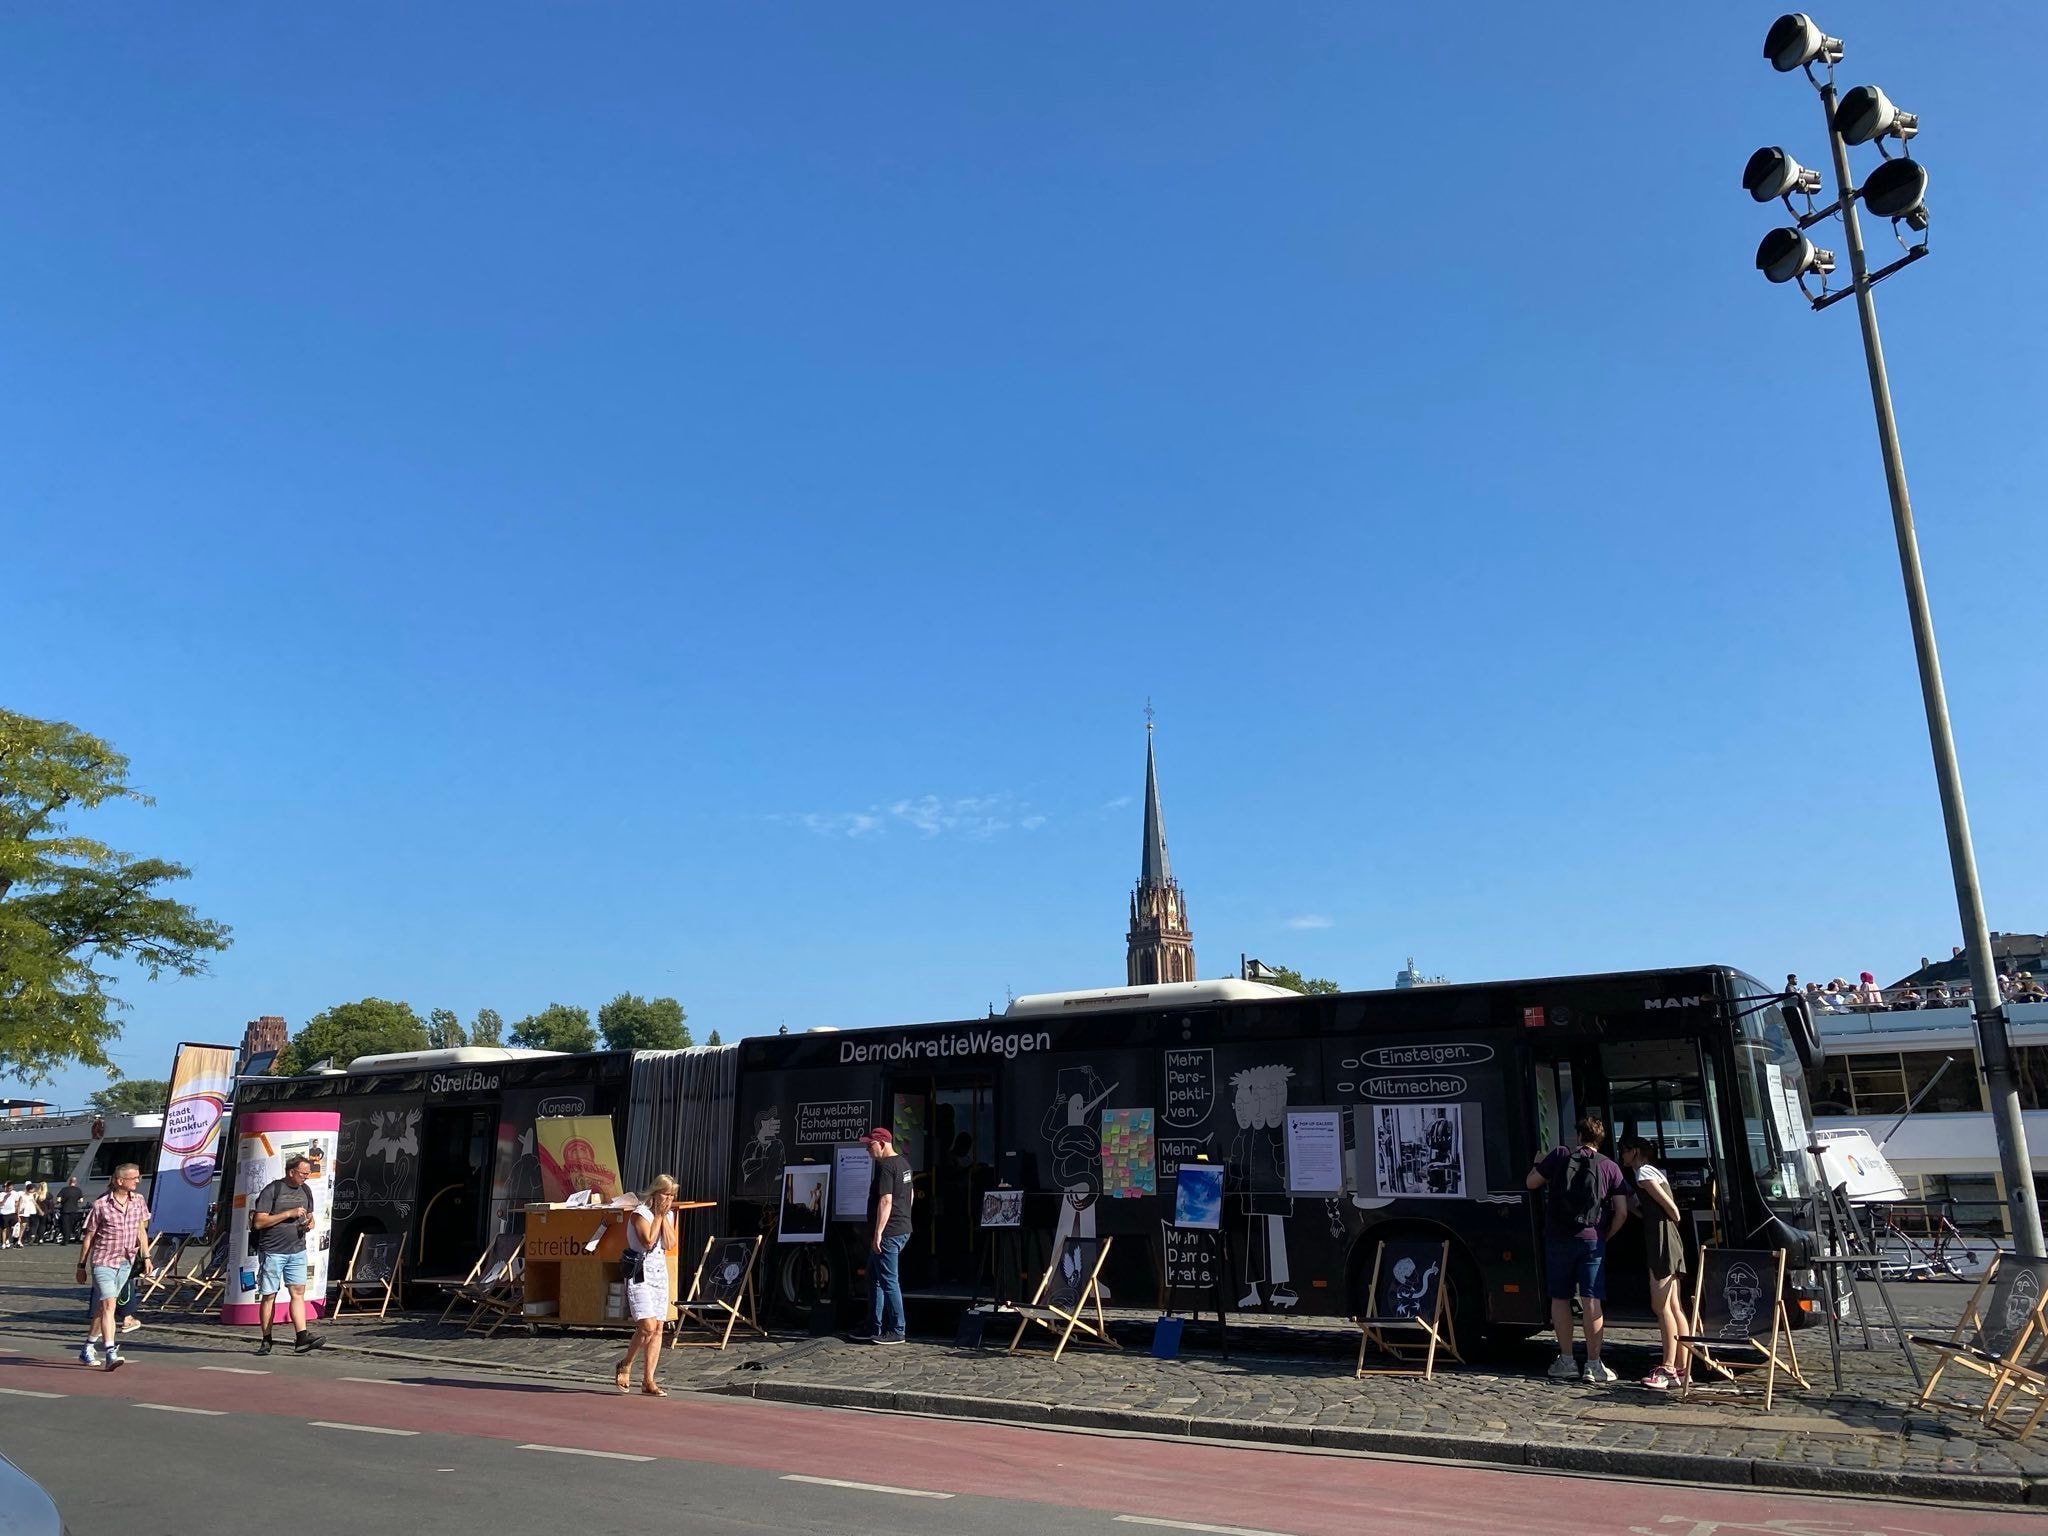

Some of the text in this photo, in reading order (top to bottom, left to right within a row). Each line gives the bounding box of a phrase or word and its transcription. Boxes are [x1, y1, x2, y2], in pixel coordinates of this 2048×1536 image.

[1644, 996, 1700, 1010] MAN
[840, 1031, 1051, 1063] DemokratieWagen
[1168, 1053, 1203, 1067] Mehr
[1379, 1046, 1470, 1065] Einsteigen.
[430, 1069, 499, 1093] StreitBus
[1169, 1070, 1206, 1084] Pers-
[1369, 1078, 1461, 1095] Mitmachen
[1169, 1087, 1211, 1104] pekti-
[168, 1107, 191, 1119] stadt
[541, 1101, 583, 1114] Konsens
[801, 1104, 865, 1117] Aus welcher
[1170, 1107, 1199, 1118] ven.
[169, 1114, 195, 1127] RAUM
[169, 1120, 208, 1135] frankfurt
[801, 1117, 868, 1129] Echokammer
[800, 1128, 864, 1141] kommst Du?
[1162, 1142, 1197, 1156] Mehr
[528, 1236, 596, 1256] streitba
